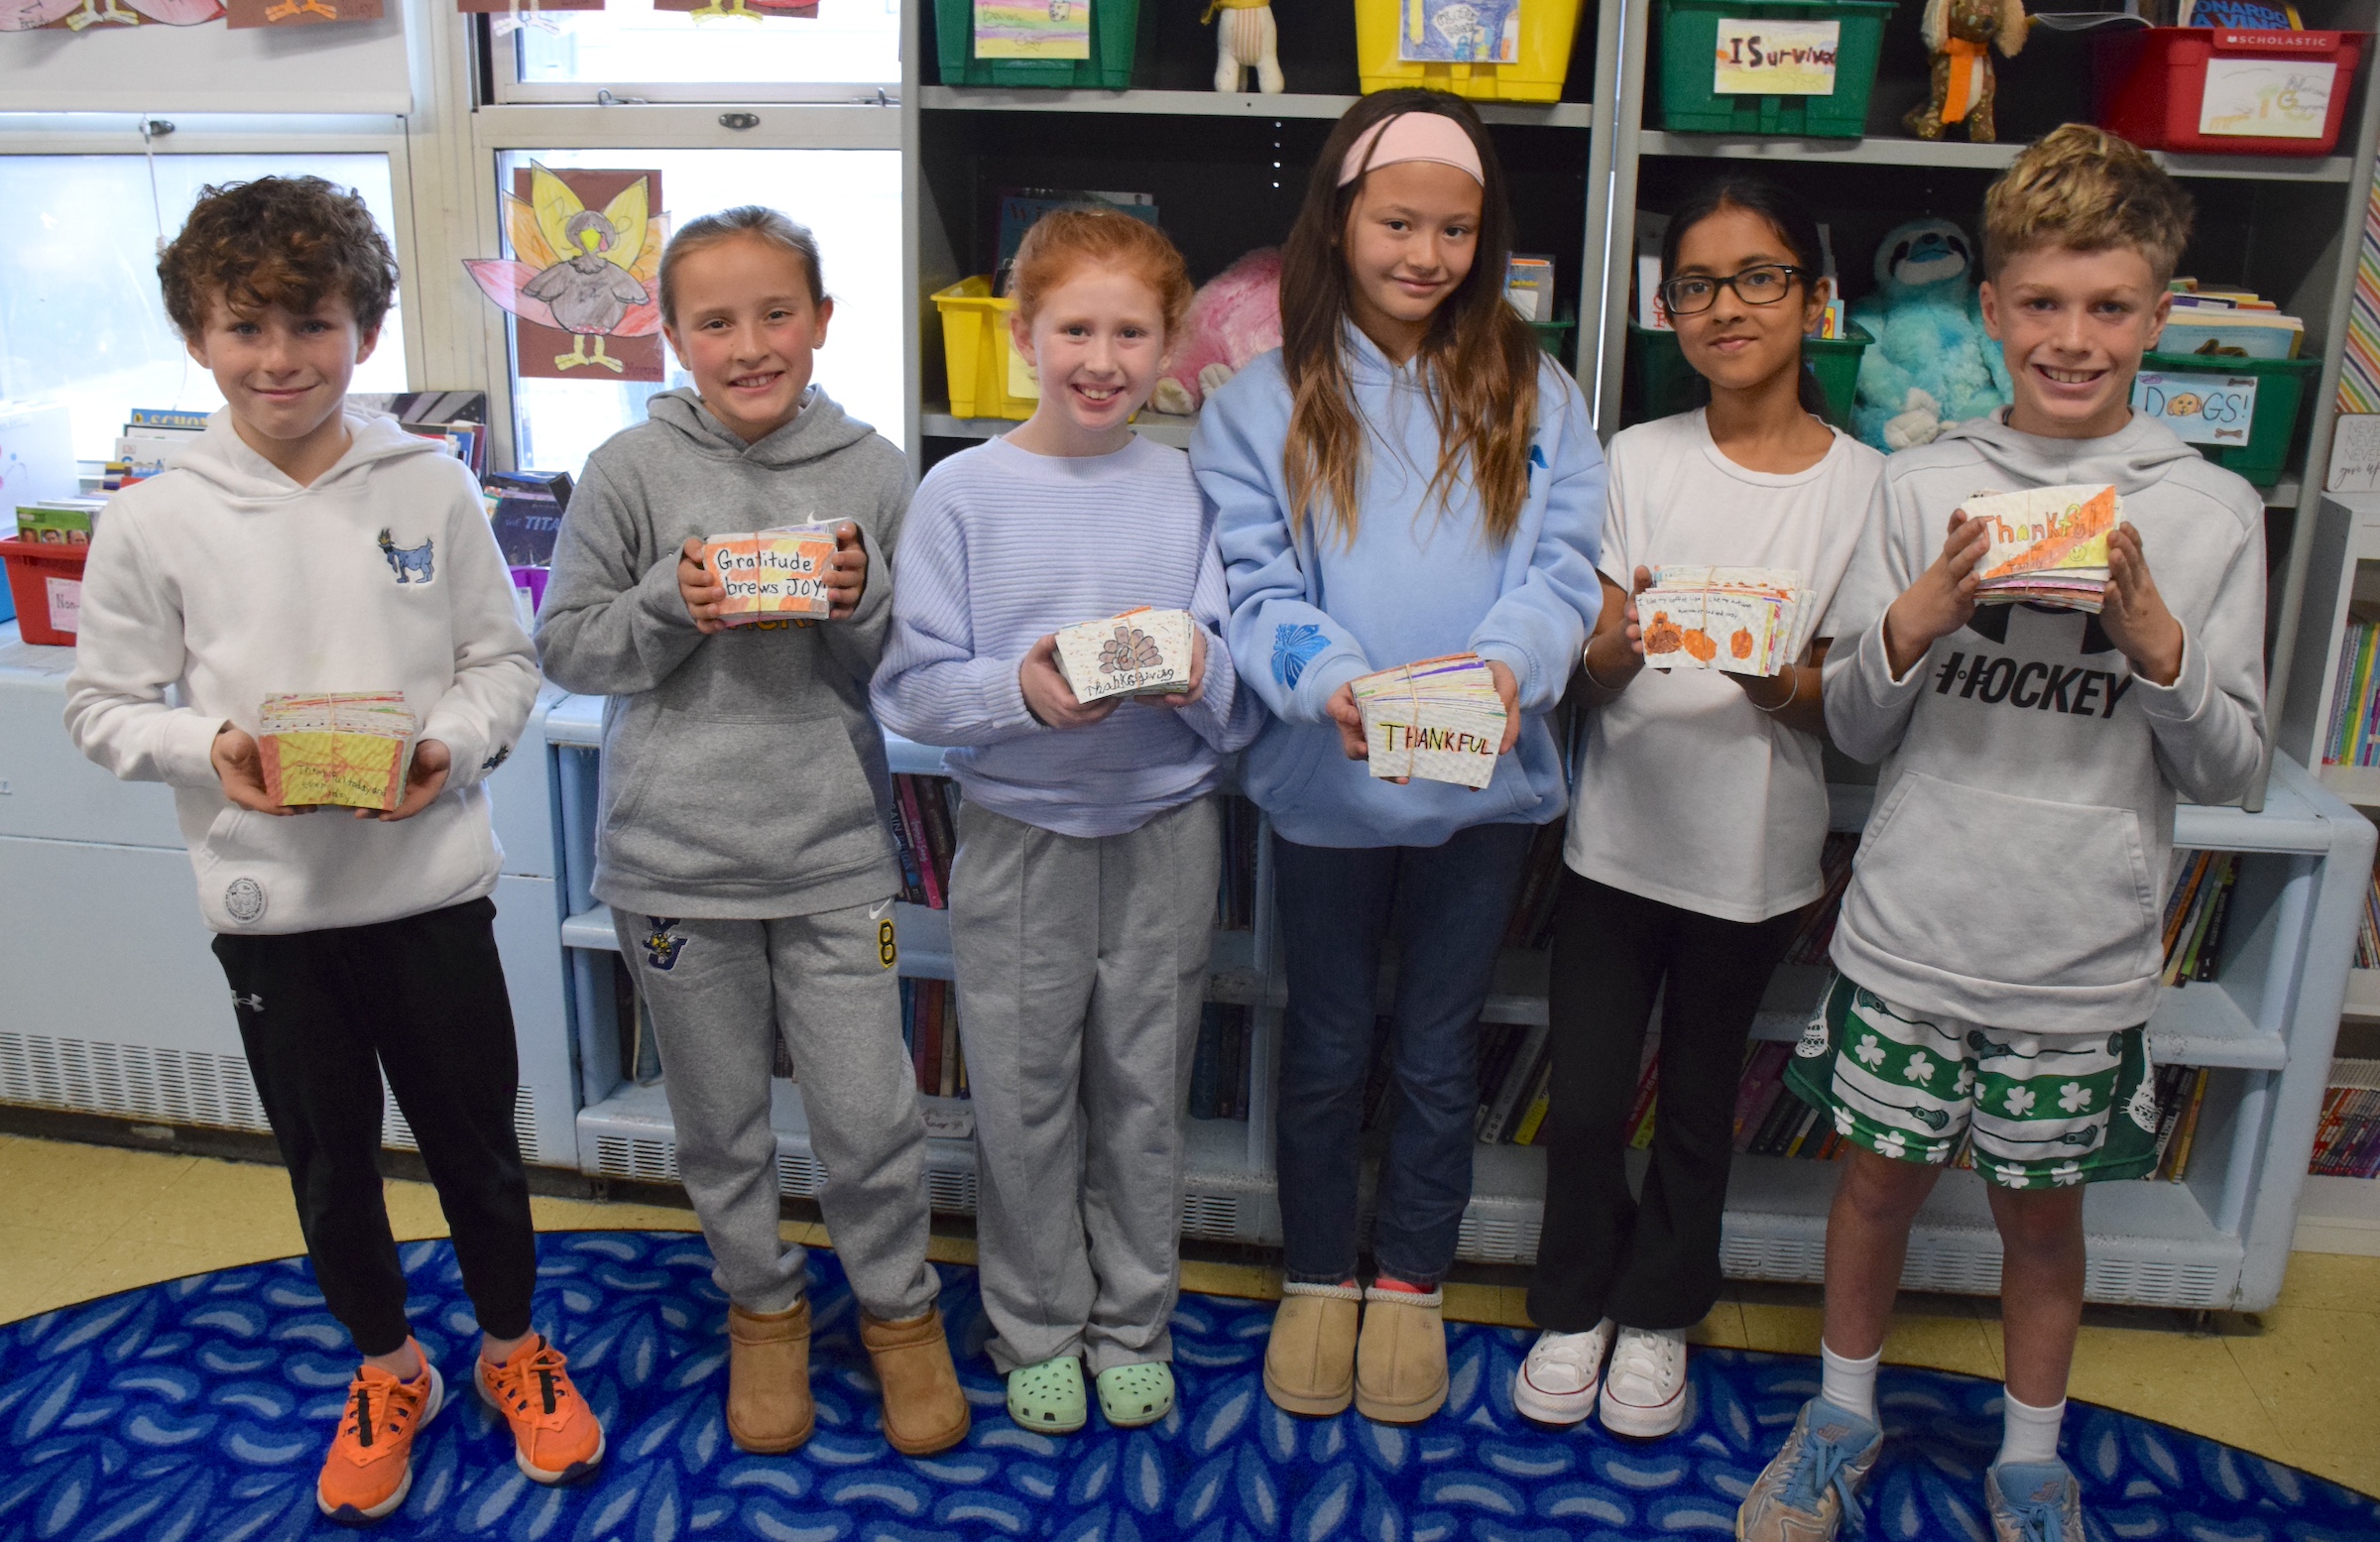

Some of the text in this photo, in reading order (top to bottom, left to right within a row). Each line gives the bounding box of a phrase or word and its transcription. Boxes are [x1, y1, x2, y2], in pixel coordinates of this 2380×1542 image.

[1729, 37, 1743, 64] I
[2238, 36, 2327, 48] SCHOLASTIC
[717, 548, 812, 572] Gratitude
[725, 576, 827, 599] brews JOY!
[1936, 652, 2134, 720] HOCKEY
[1379, 722, 1493, 756] THANKFUL
[347, 778, 372, 796] today
[372, 785, 388, 797] and
[879, 918, 896, 968] 8
